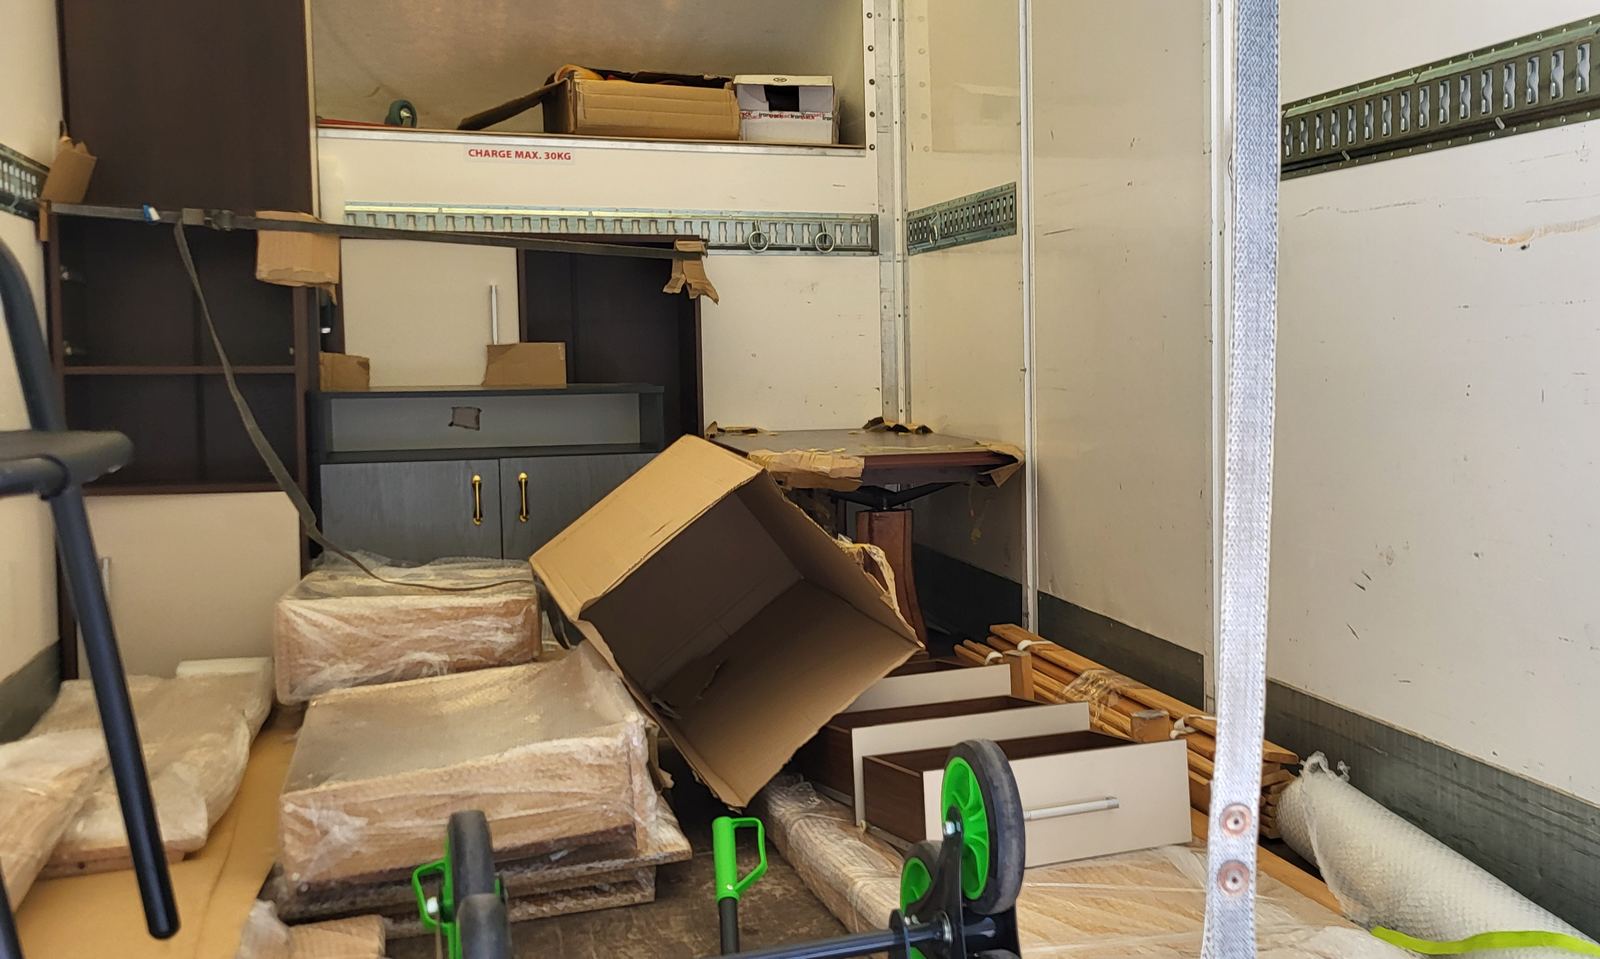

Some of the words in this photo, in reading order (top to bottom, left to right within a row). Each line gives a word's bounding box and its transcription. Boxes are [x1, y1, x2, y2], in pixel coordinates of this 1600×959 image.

[468, 149, 512, 158] CHARGE
[514, 150, 542, 160] MAX.
[544, 151, 571, 160] 30KG
